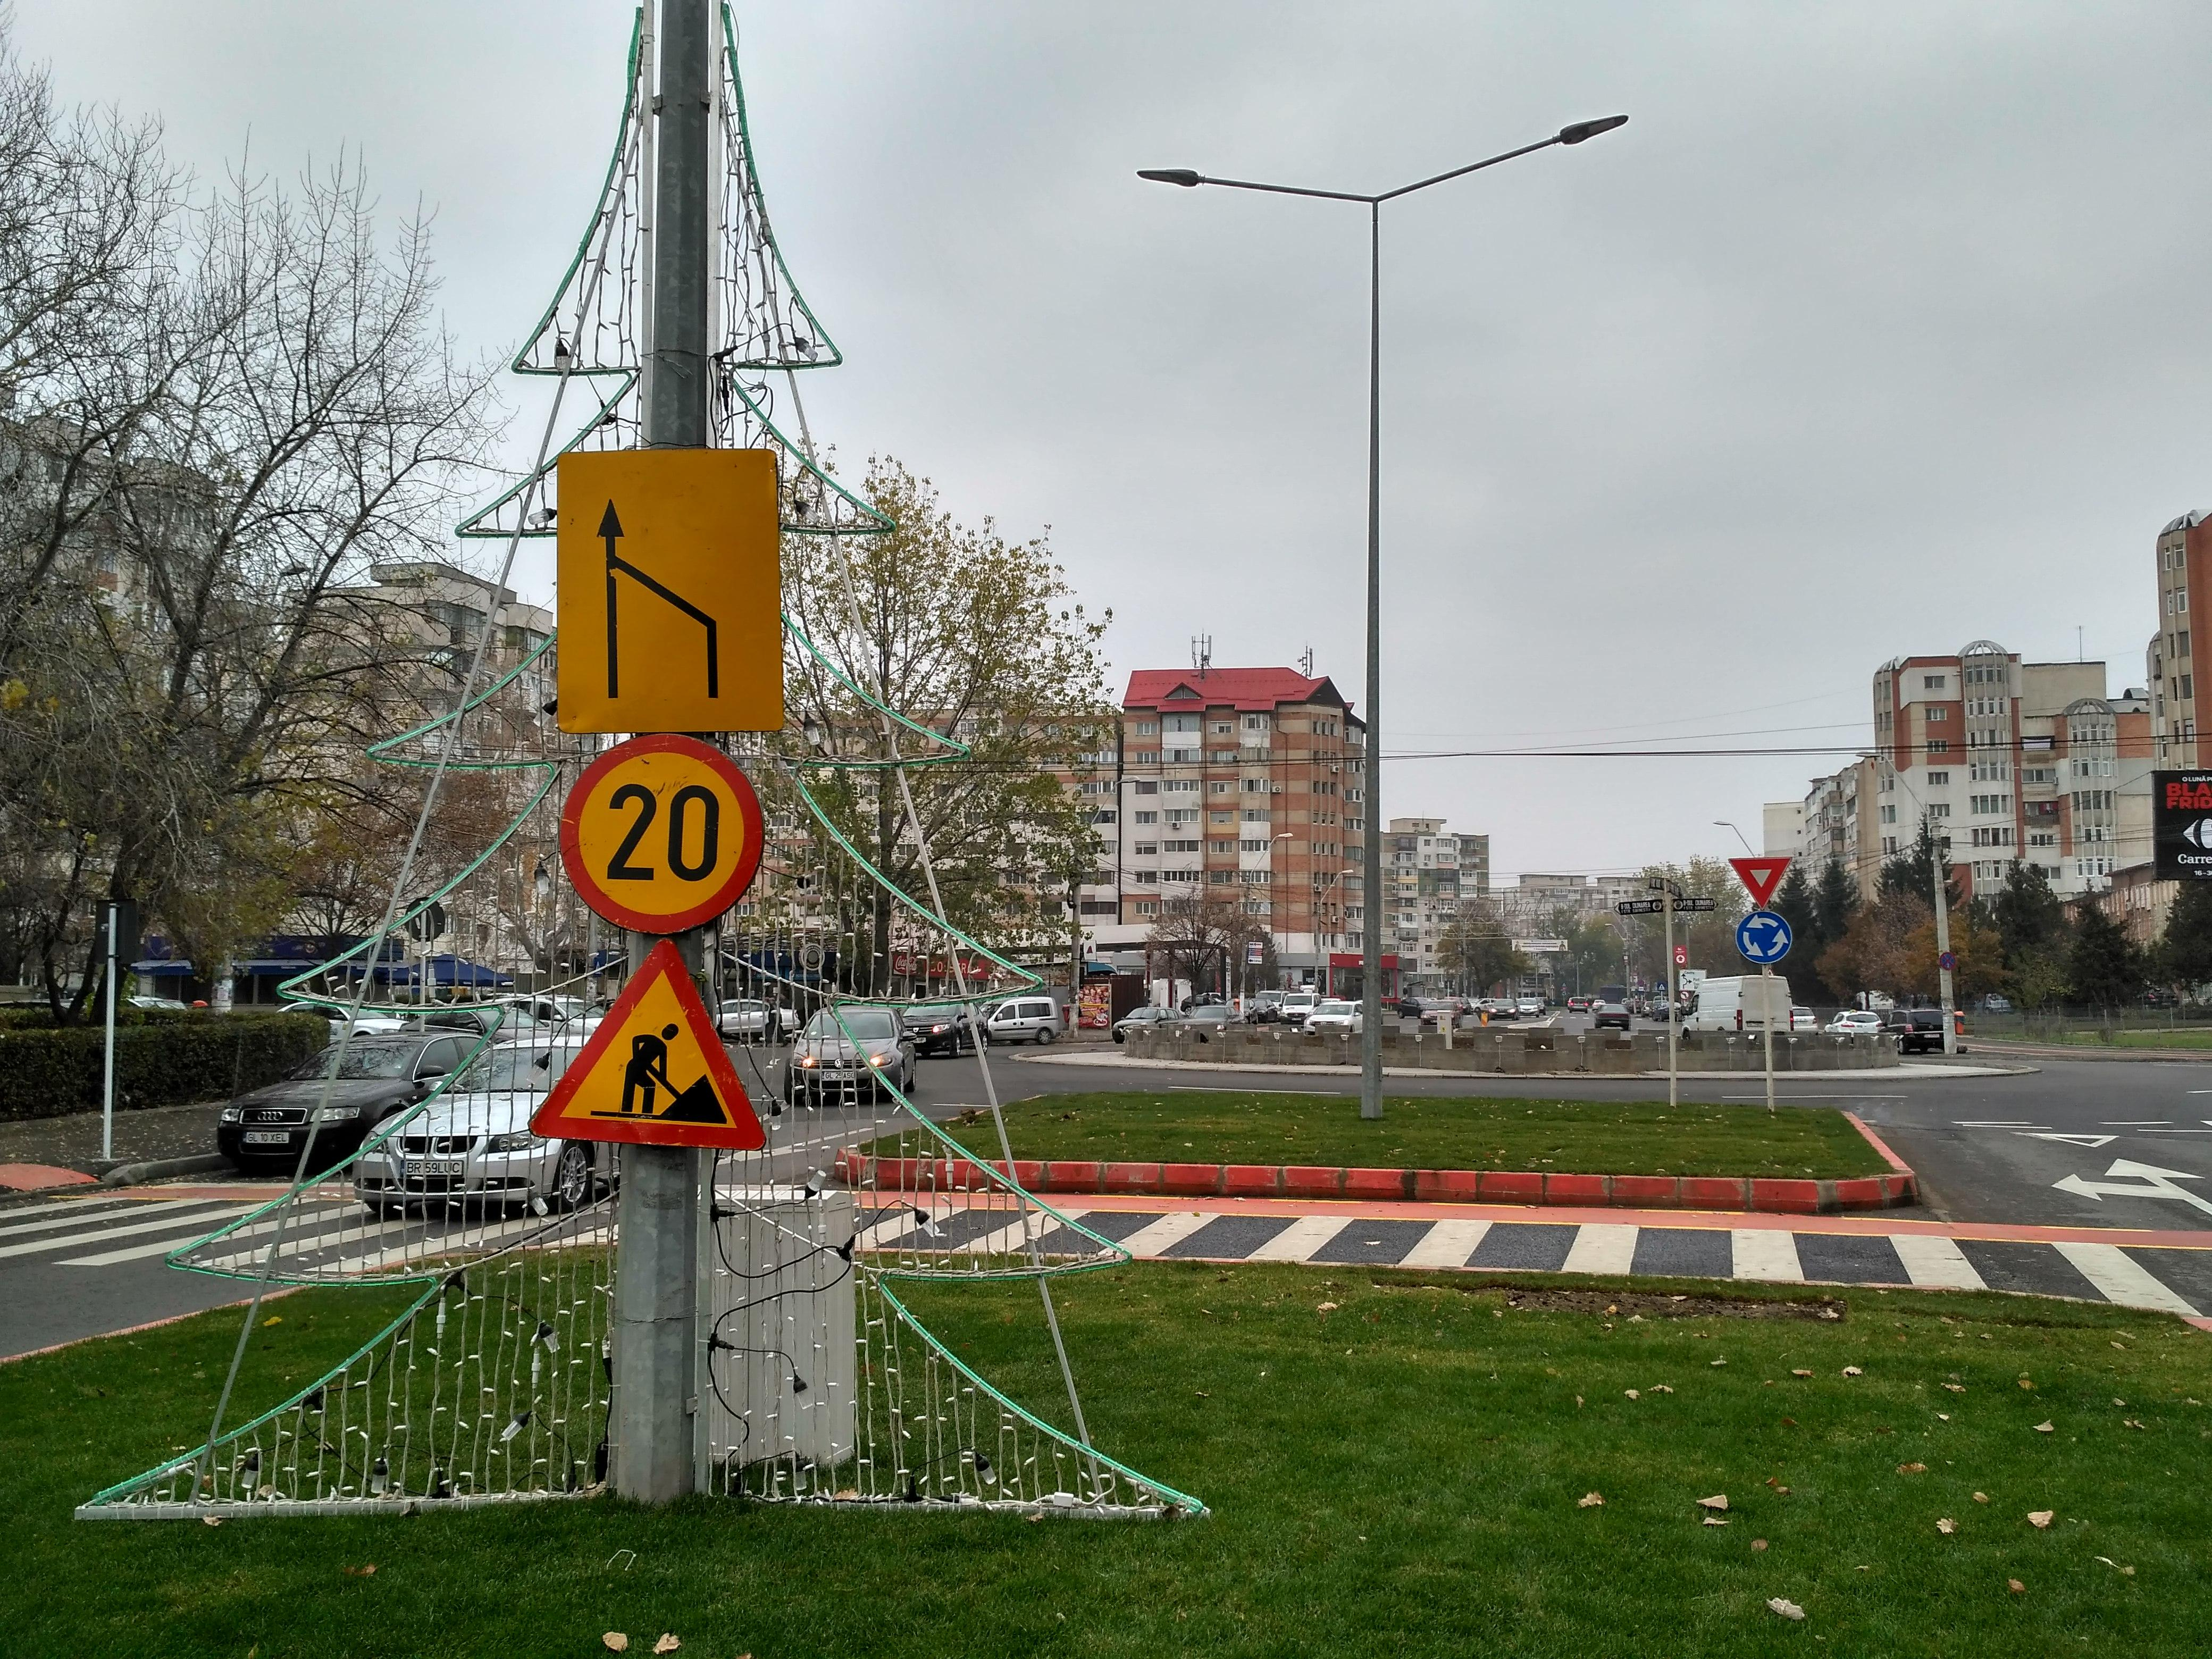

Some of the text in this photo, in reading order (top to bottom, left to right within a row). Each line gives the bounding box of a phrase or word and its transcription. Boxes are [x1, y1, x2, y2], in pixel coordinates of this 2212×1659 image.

[2166, 782, 2212, 797] BLA
[607, 783, 719, 882] 20
[407, 1163, 421, 1173] BR
